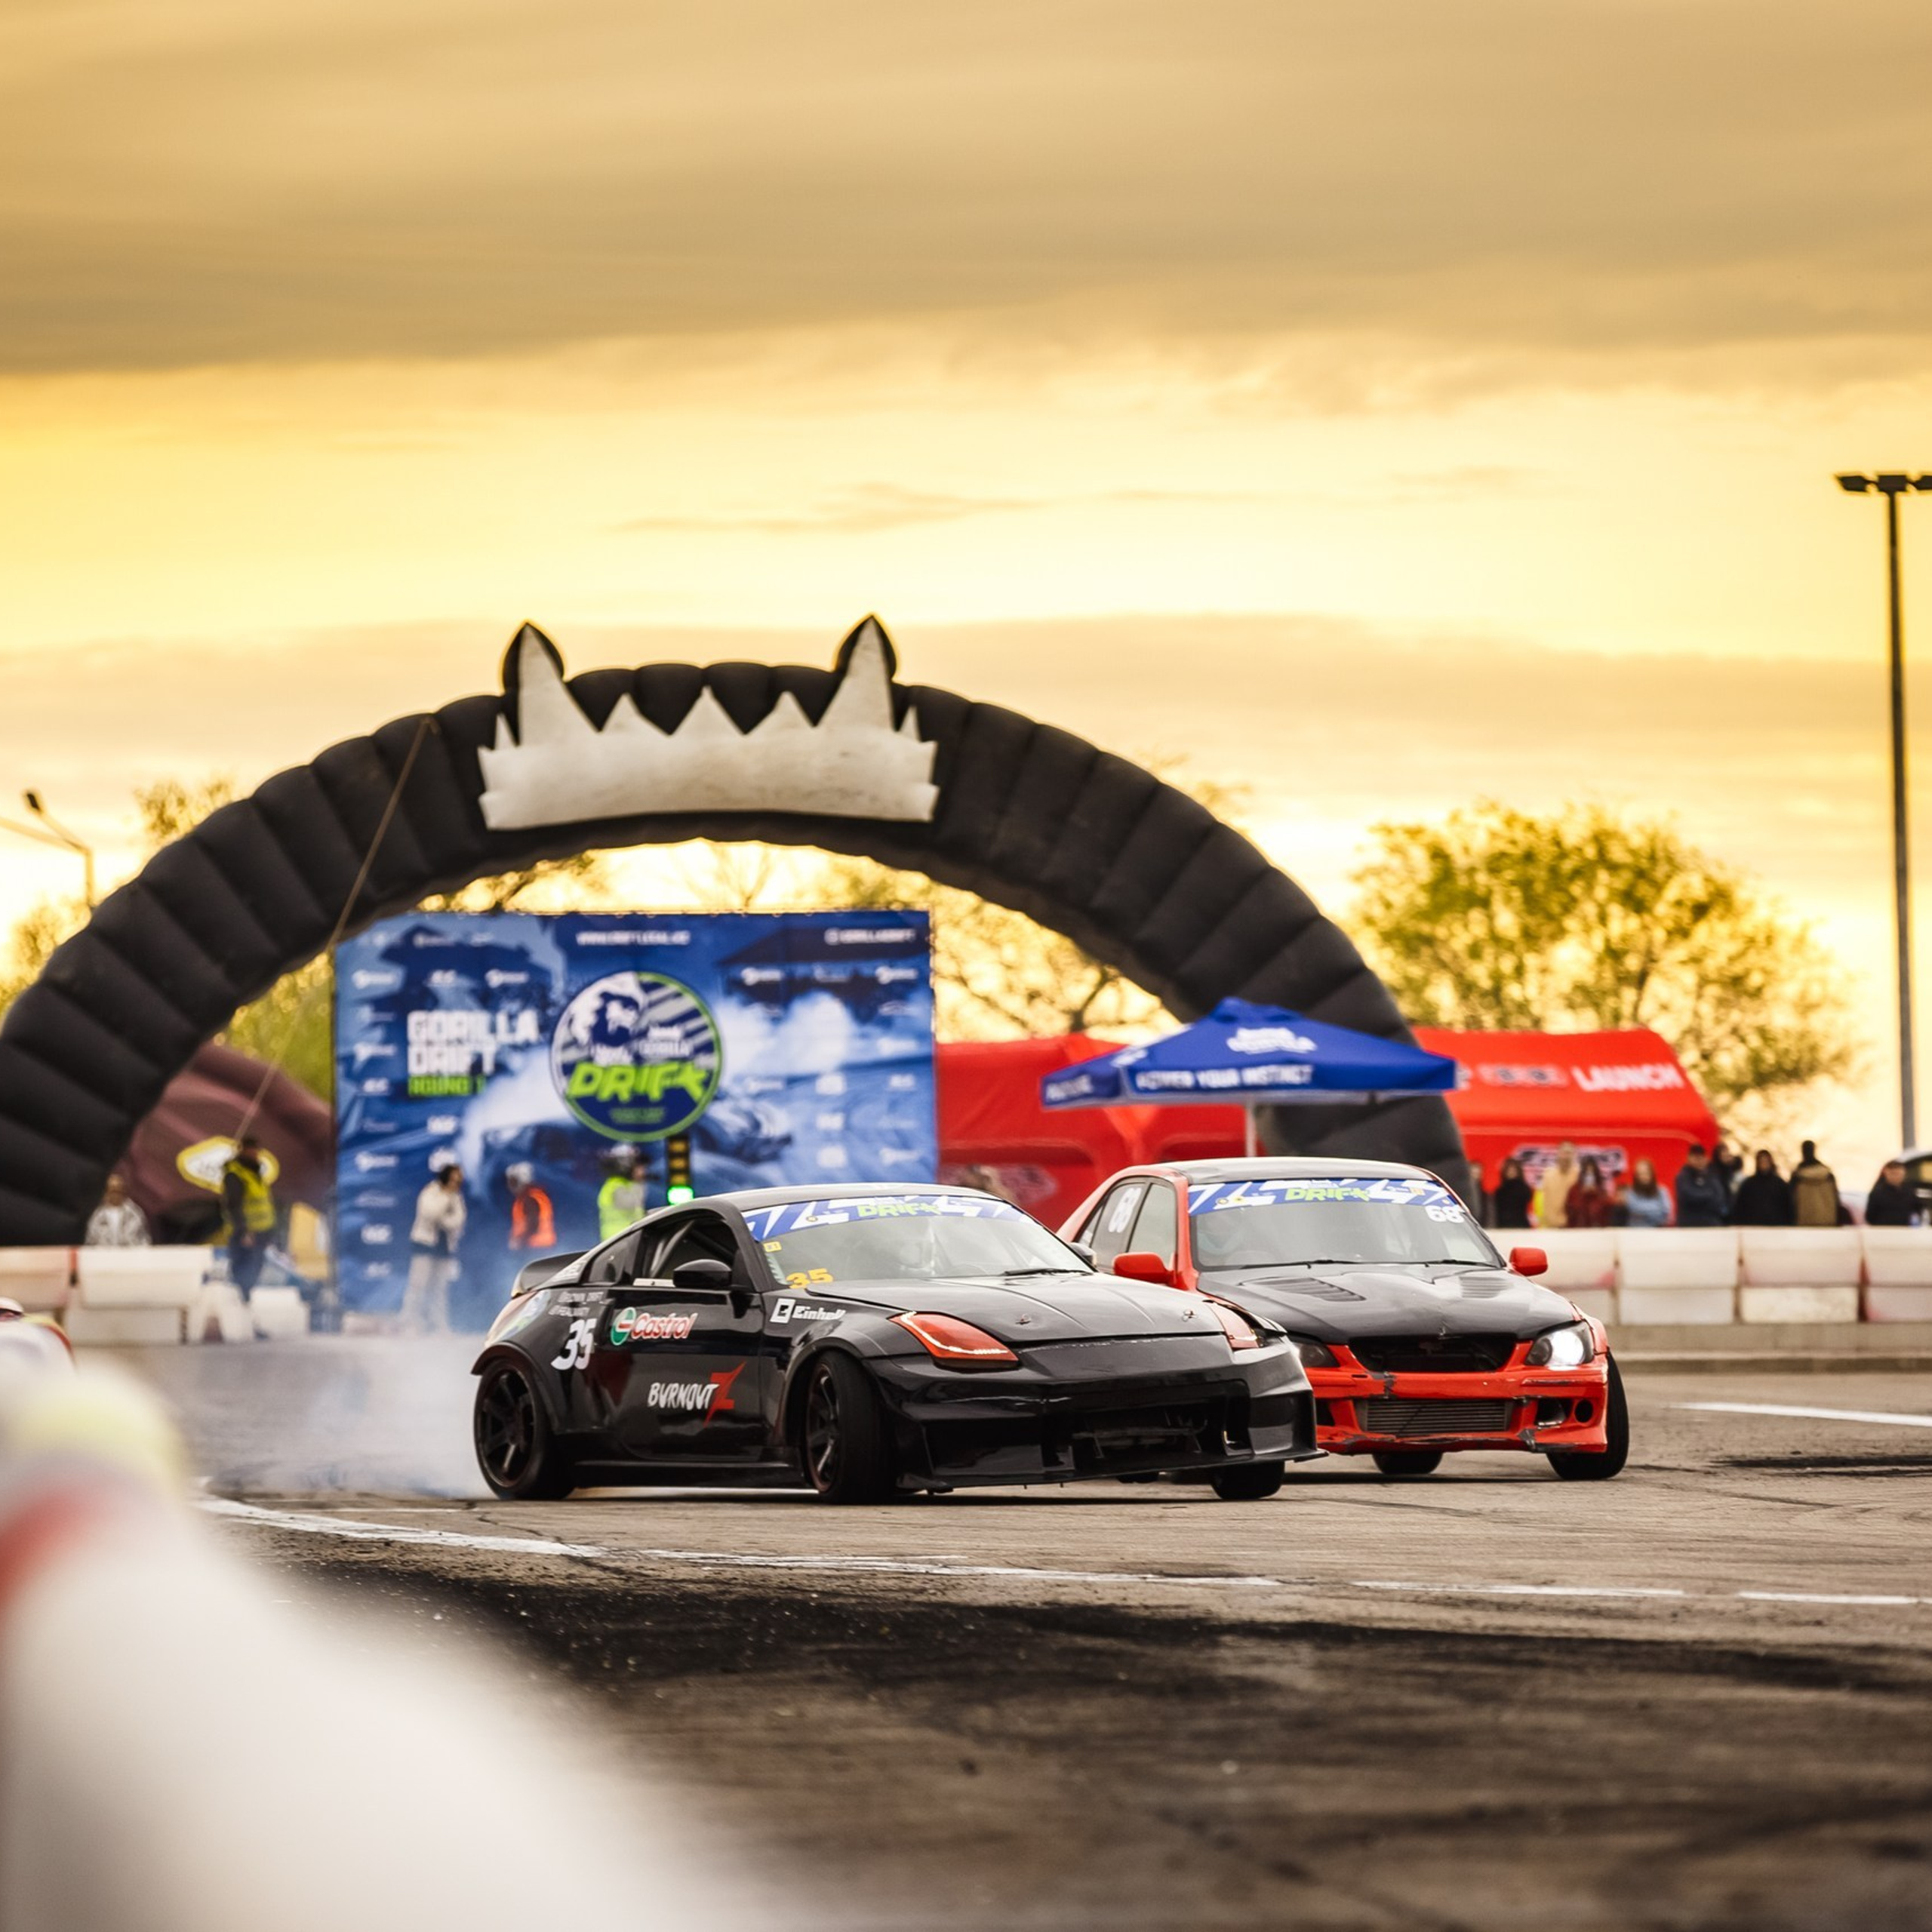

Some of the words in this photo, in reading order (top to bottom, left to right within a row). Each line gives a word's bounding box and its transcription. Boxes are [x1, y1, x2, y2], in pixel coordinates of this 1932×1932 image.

[408, 1010, 539, 1042] GORILLA
[408, 1043, 496, 1075] DRIFT
[1571, 1063, 1684, 1091] LAUNCH
[1424, 1204, 1466, 1223] 68
[786, 1268, 834, 1289] 35
[632, 1312, 699, 1340] Castrol
[550, 1318, 598, 1371] 35
[647, 1382, 721, 1411] BURNOUT
